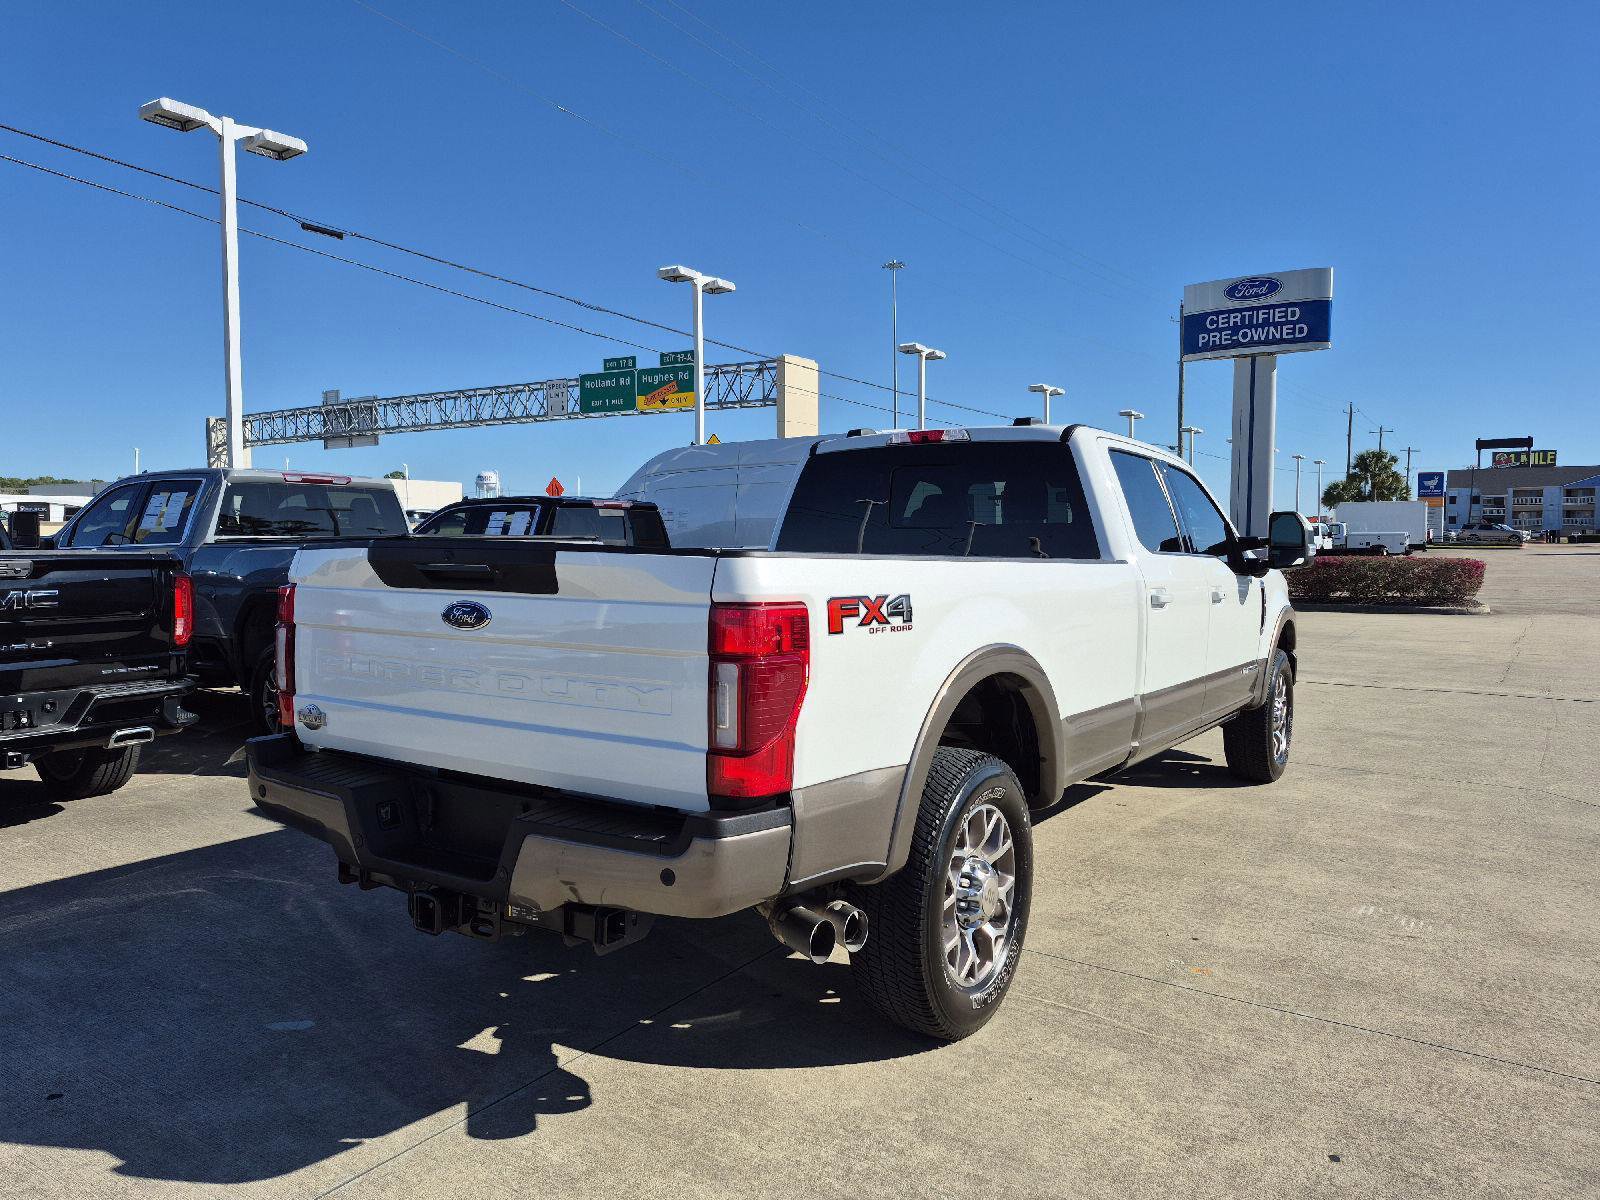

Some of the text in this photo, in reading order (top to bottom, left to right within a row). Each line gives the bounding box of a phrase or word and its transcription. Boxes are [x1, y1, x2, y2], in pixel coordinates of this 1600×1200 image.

[1234, 280, 1268, 297] Ford
[1206, 307, 1300, 329] CERTIFIED
[1198, 324, 1308, 347] PRE-OWNED
[585, 376, 631, 389] Holland Rd
[642, 370, 689, 384] Hughes Rd
[549, 391, 564, 399] LMT
[671, 396, 688, 404] ONLY
[450, 606, 478, 623] Ford
[827, 594, 913, 634] FX4
[869, 624, 913, 634] OFF ROAD
[497, 673, 666, 707] DUTY
